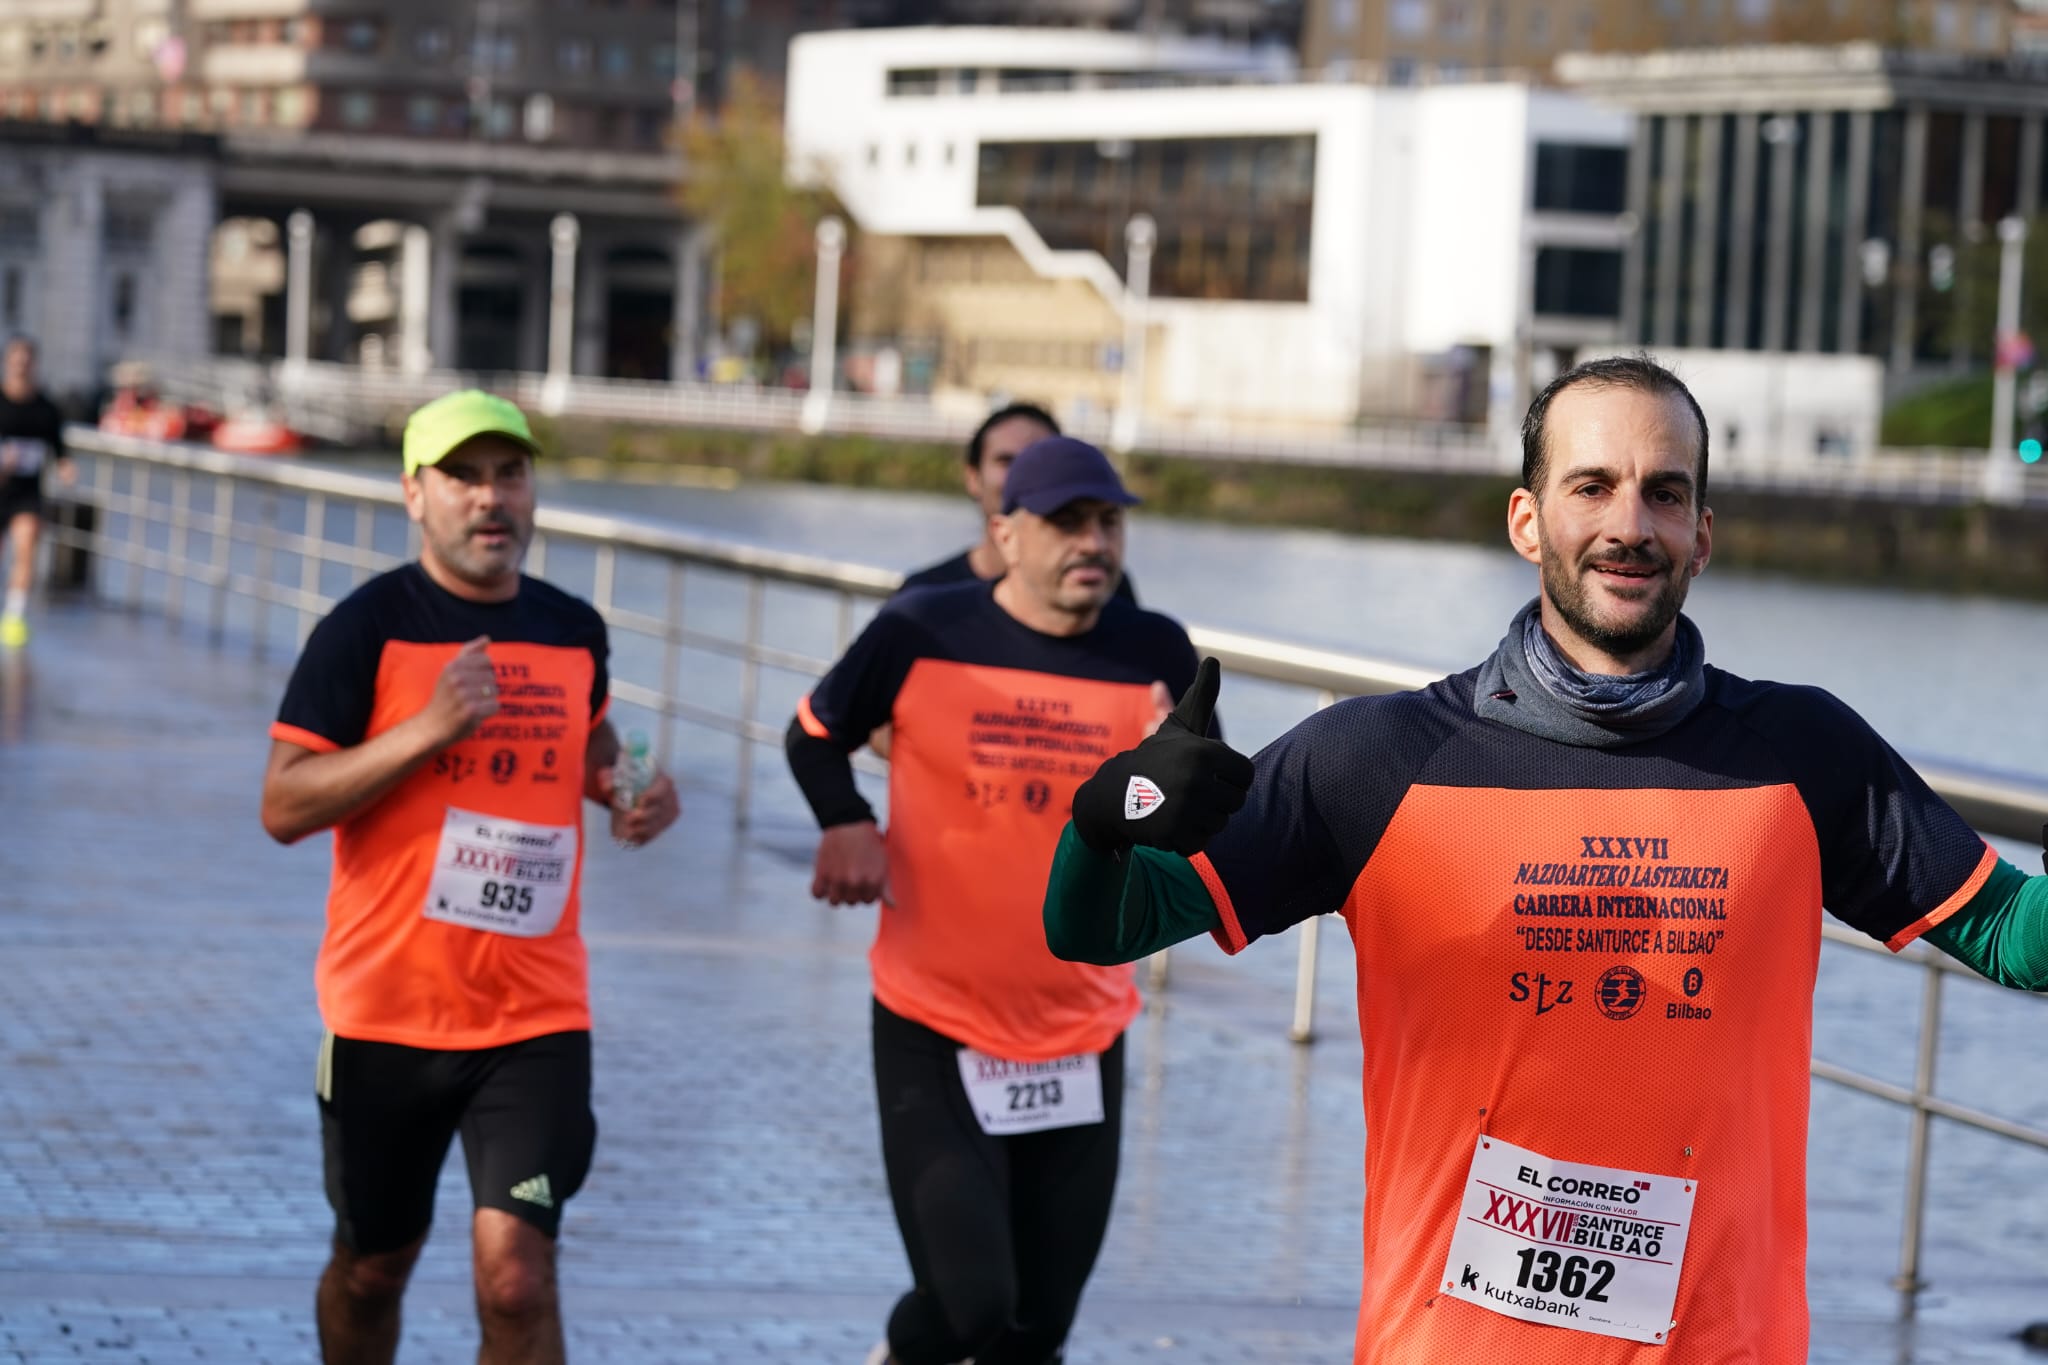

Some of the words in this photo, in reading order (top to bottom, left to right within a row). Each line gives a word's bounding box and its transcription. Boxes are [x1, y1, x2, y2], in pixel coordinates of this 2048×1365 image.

[1580, 837, 1669, 860] XXXVII
[1514, 863, 1630, 888] NAZIOARTEKO
[1630, 866, 1729, 889] LASTERKETA
[481, 879, 536, 915] 935
[1514, 894, 1592, 918] CARRERA
[1597, 896, 1727, 920] INTERNACIONAL
[1576, 929, 1649, 953] SANTURCE
[1653, 930, 1663, 953] A
[1667, 1003, 1712, 1020] Bilbao
[1007, 1079, 1063, 1111] 2213
[1517, 1165, 1543, 1189] EL
[1547, 1176, 1641, 1204] CORREO
[1542, 1195, 1594, 1209] INFORMACIÓN
[1595, 1203, 1612, 1212] CON
[1613, 1206, 1638, 1216] VALOR
[1578, 1214, 1664, 1240] SANTURCE
[1516, 1247, 1616, 1303] 1362
[1484, 1281, 1581, 1318] kutxabank
